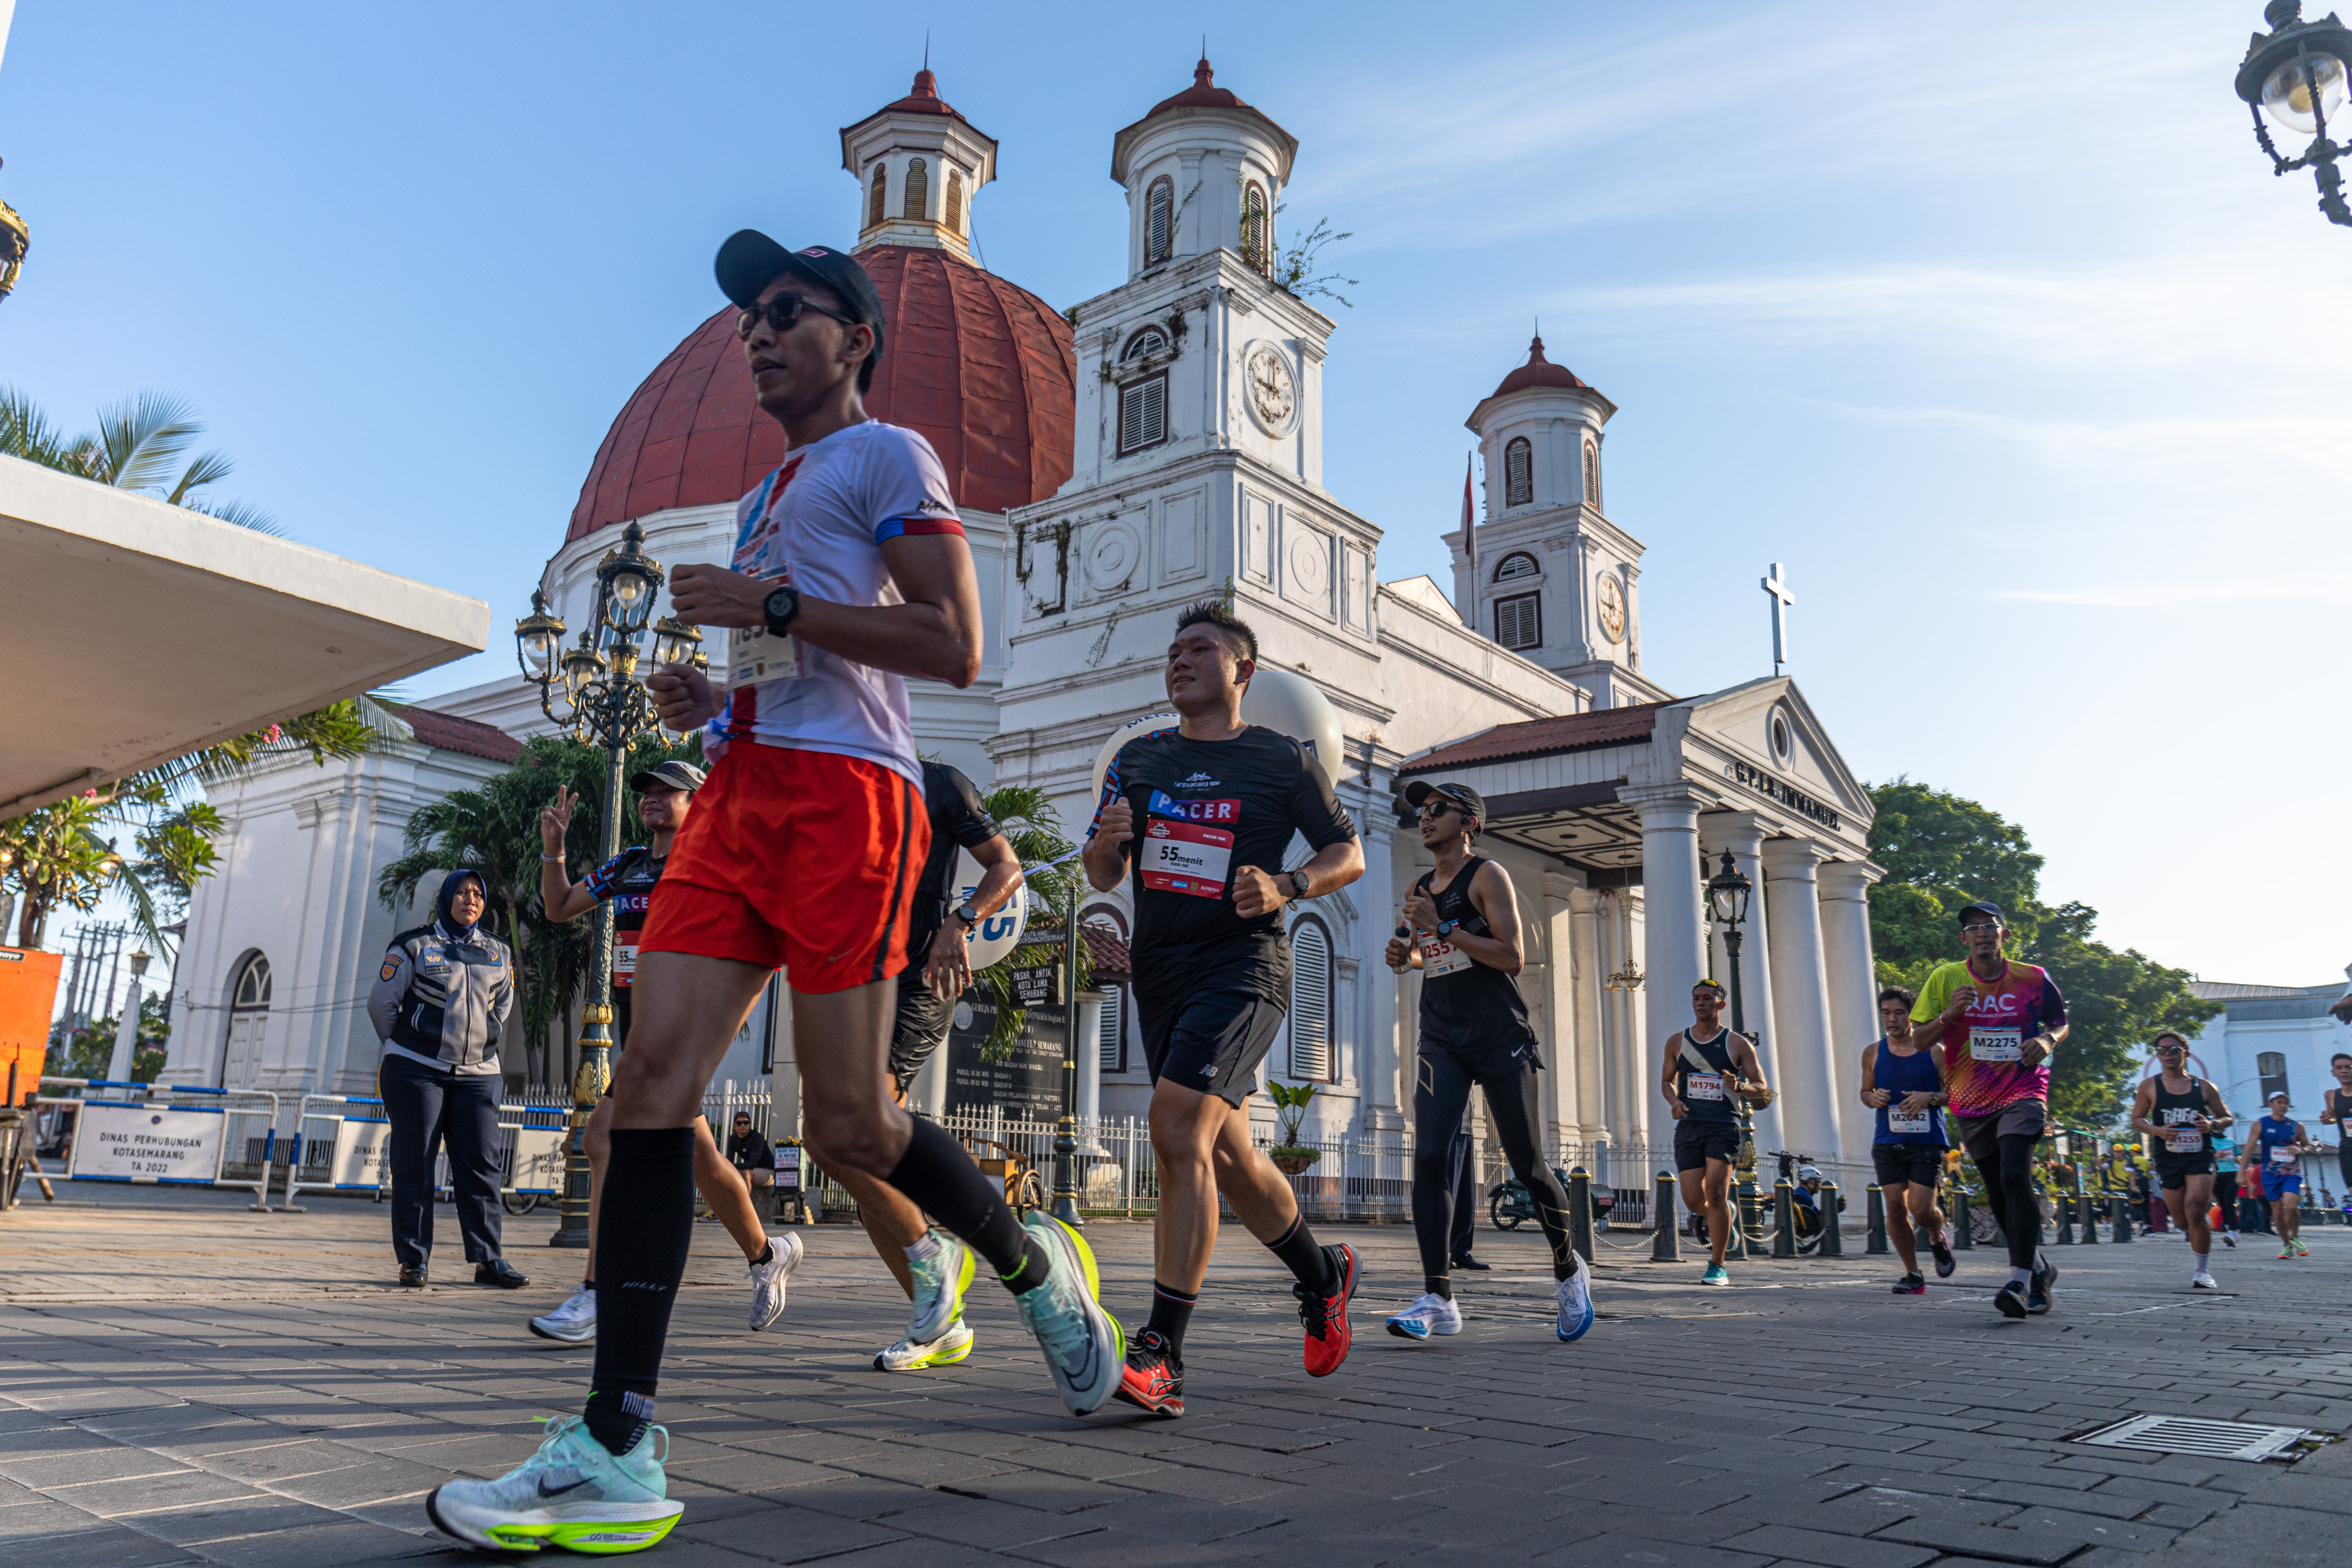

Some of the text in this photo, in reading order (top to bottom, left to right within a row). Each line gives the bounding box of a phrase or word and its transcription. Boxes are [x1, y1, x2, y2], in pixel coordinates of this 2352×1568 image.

[1158, 794, 1231, 818] PACER
[1420, 941, 1457, 960] M255
[1014, 968, 1051, 981] PASAR ANTIK
[1018, 978, 1048, 991] KOTA LAMA
[1020, 988, 1047, 999] SEMARANG
[971, 1003, 990, 1014] GEREJA
[1048, 1014, 1061, 1024] bagian
[1037, 1041, 1061, 1051] SEMARANG
[1973, 1037, 2017, 1047] M2275
[1690, 1081, 1720, 1090] M1794
[100, 1132, 202, 1148] DINAS PERHUBUNGAN
[113, 1146, 185, 1160] KOTASEMARANG
[354, 1146, 376, 1155] DINAS
[532, 1154, 551, 1162] DINAS
[132, 1162, 168, 1173] TA 2022
[376, 1171, 383, 1179] TA
